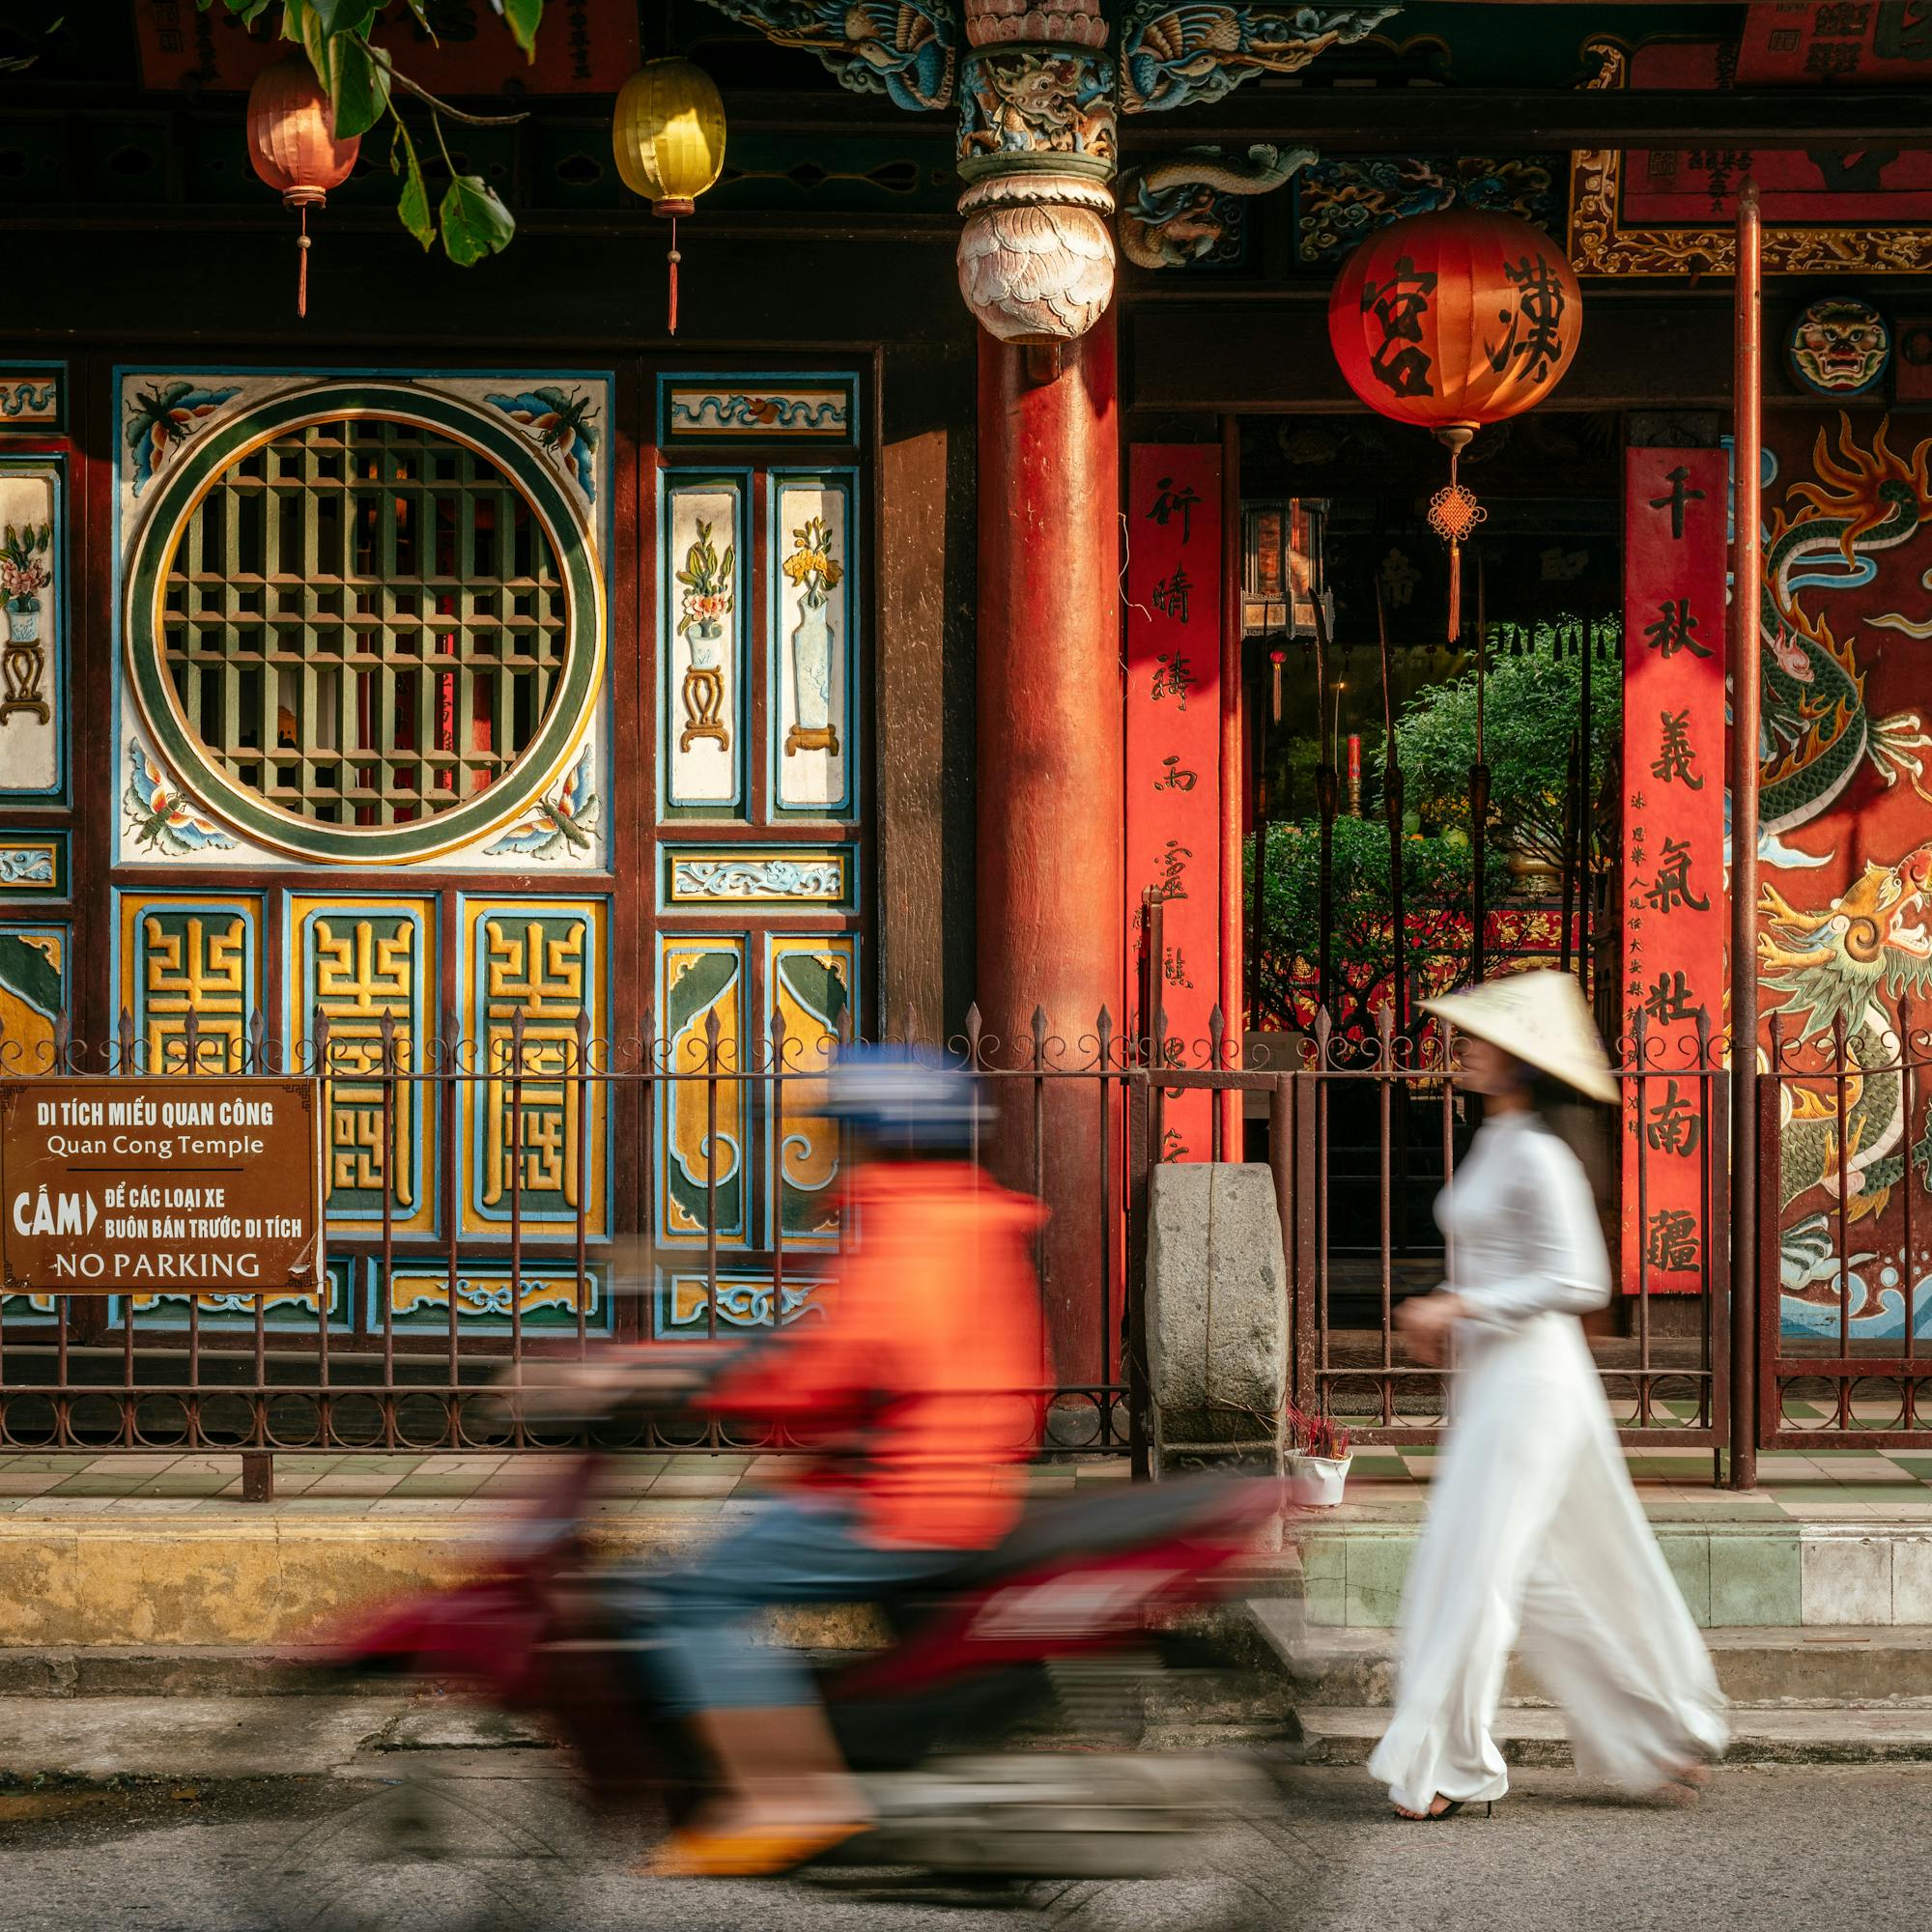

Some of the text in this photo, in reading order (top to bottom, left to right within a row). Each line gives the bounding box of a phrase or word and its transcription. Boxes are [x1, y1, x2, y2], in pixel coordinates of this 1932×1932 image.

[38, 1095, 273, 1128] DI TÍCH MIẾU QUAN CÔNG
[47, 1135, 264, 1159] Quan Cong Temple
[14, 1183, 82, 1236] CẤM
[104, 1181, 225, 1211] ĐỂ CÁC LOẠI XE
[105, 1215, 302, 1237] BUÔN BÁN TRƯỚC DI TÍCH
[56, 1253, 260, 1277] NO PARKING
